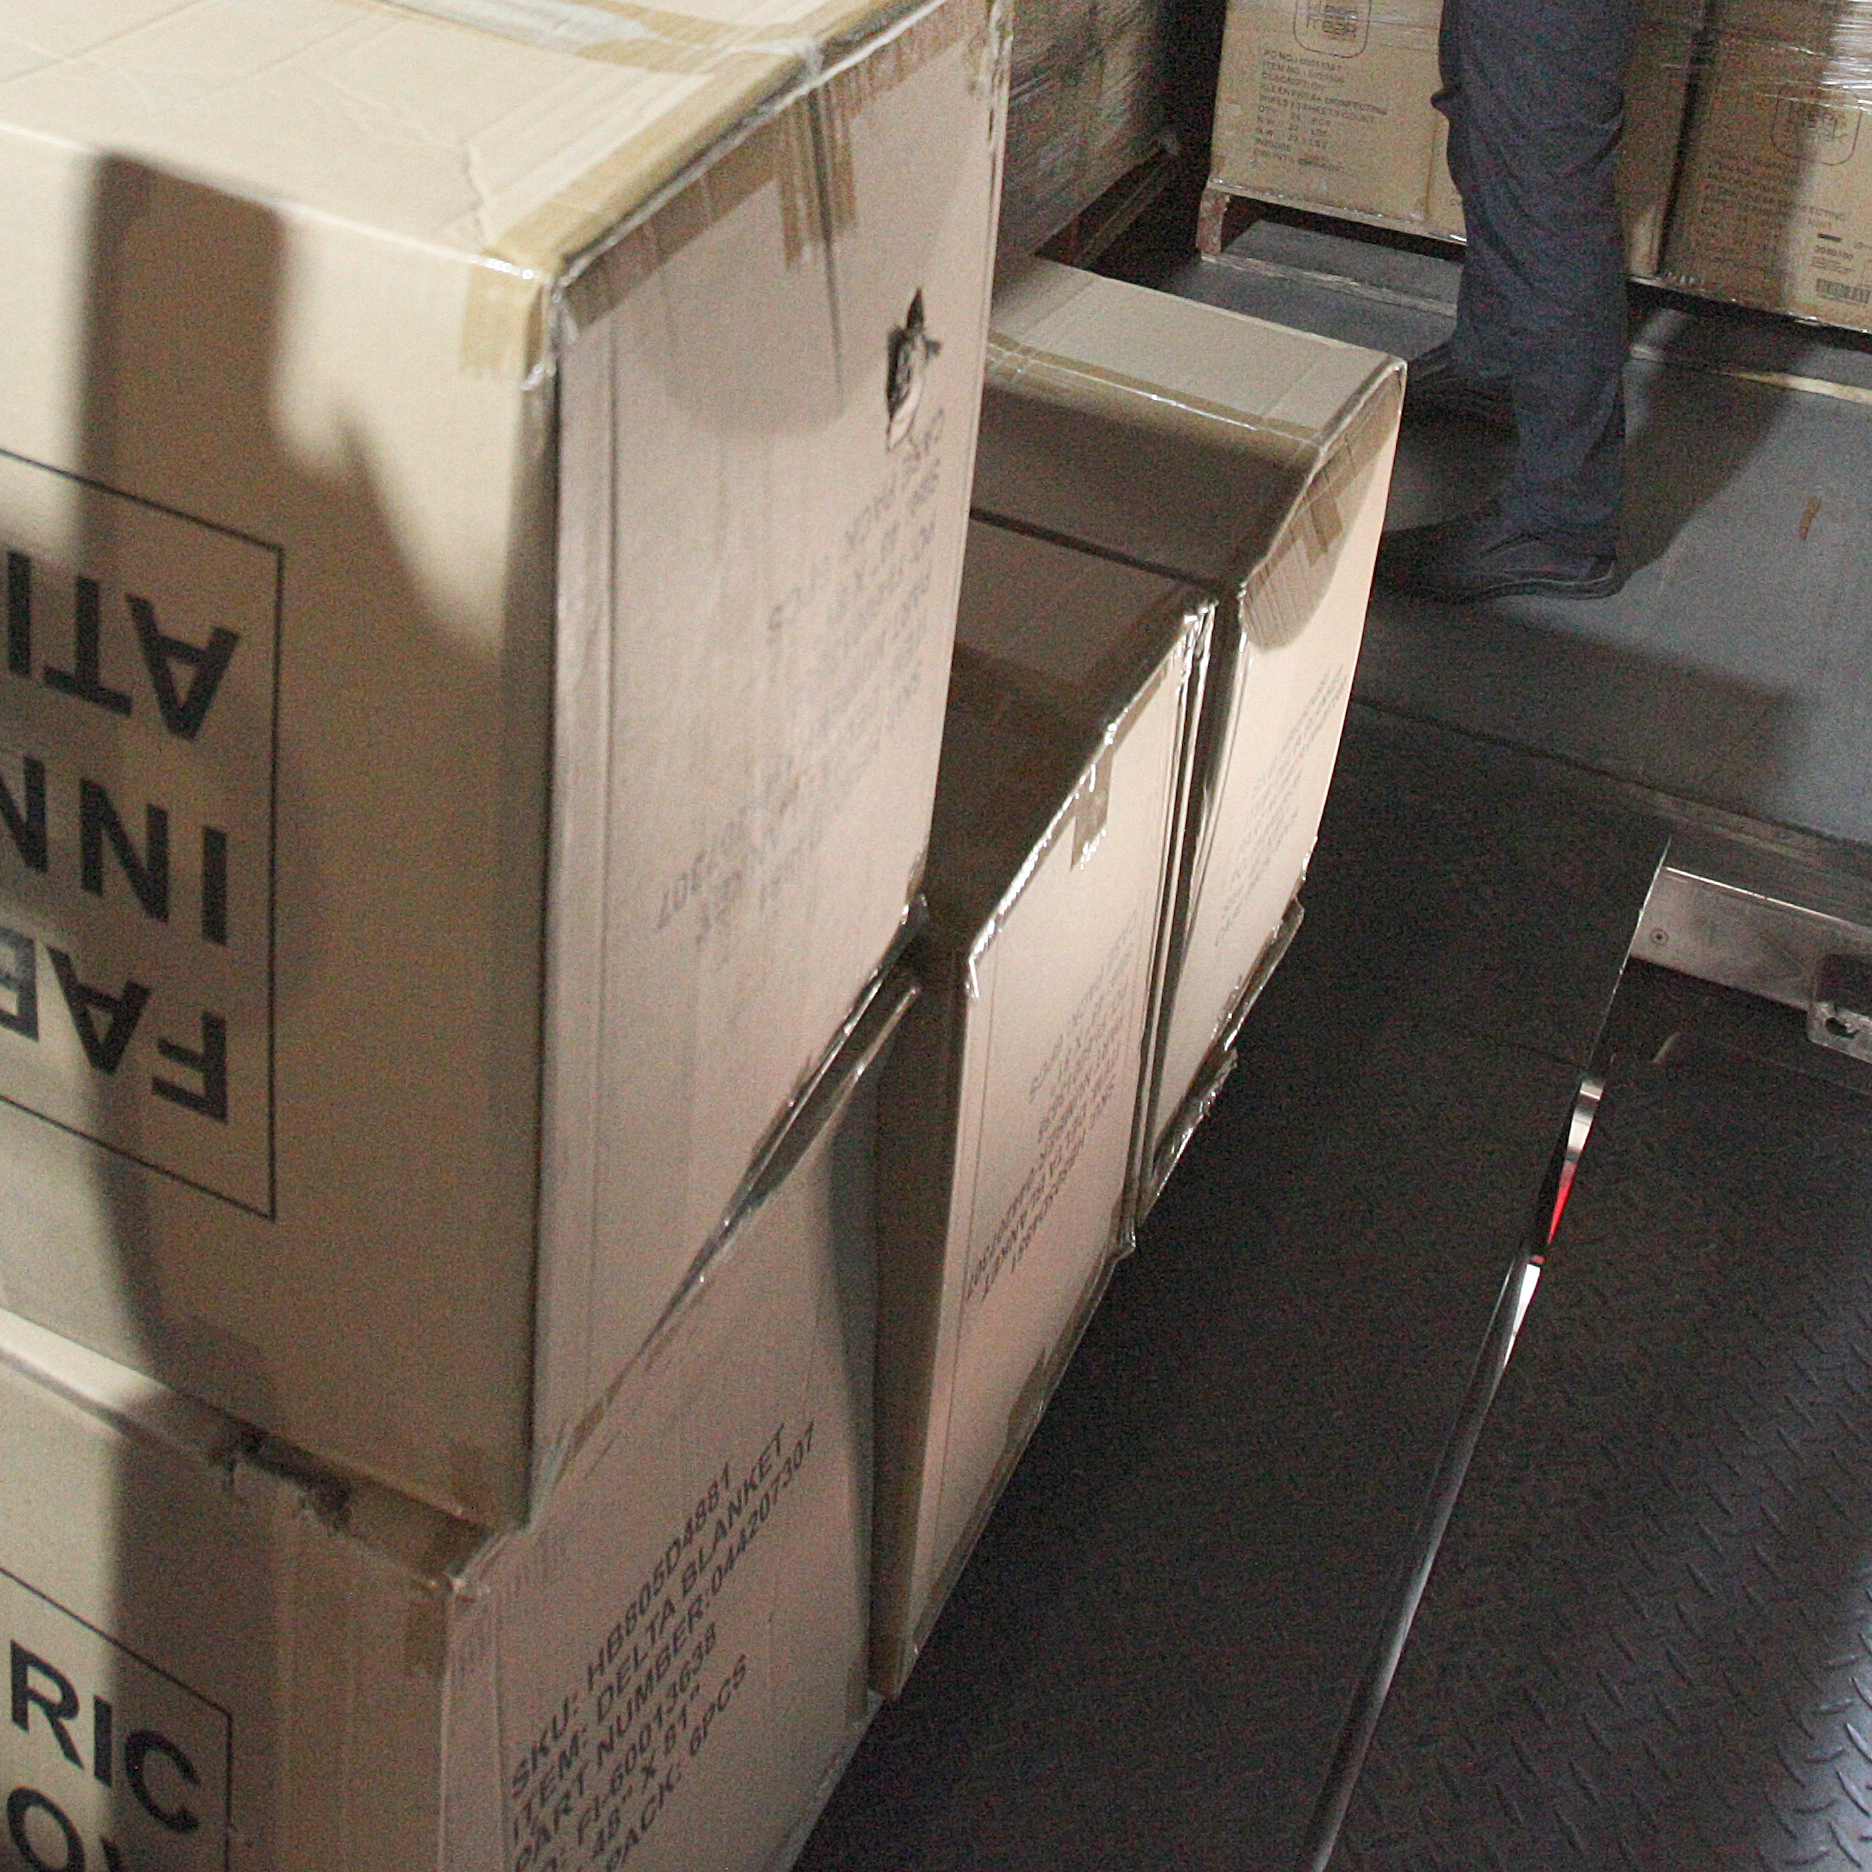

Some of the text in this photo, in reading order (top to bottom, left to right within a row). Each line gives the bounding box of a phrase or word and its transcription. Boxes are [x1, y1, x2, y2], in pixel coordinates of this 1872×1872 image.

[512, 1460, 732, 1798] SKU: HB805D4881
[513, 1423, 786, 1844] ITEM: DELTA BLANKET
[689, 1653, 748, 1758] 6PCS
